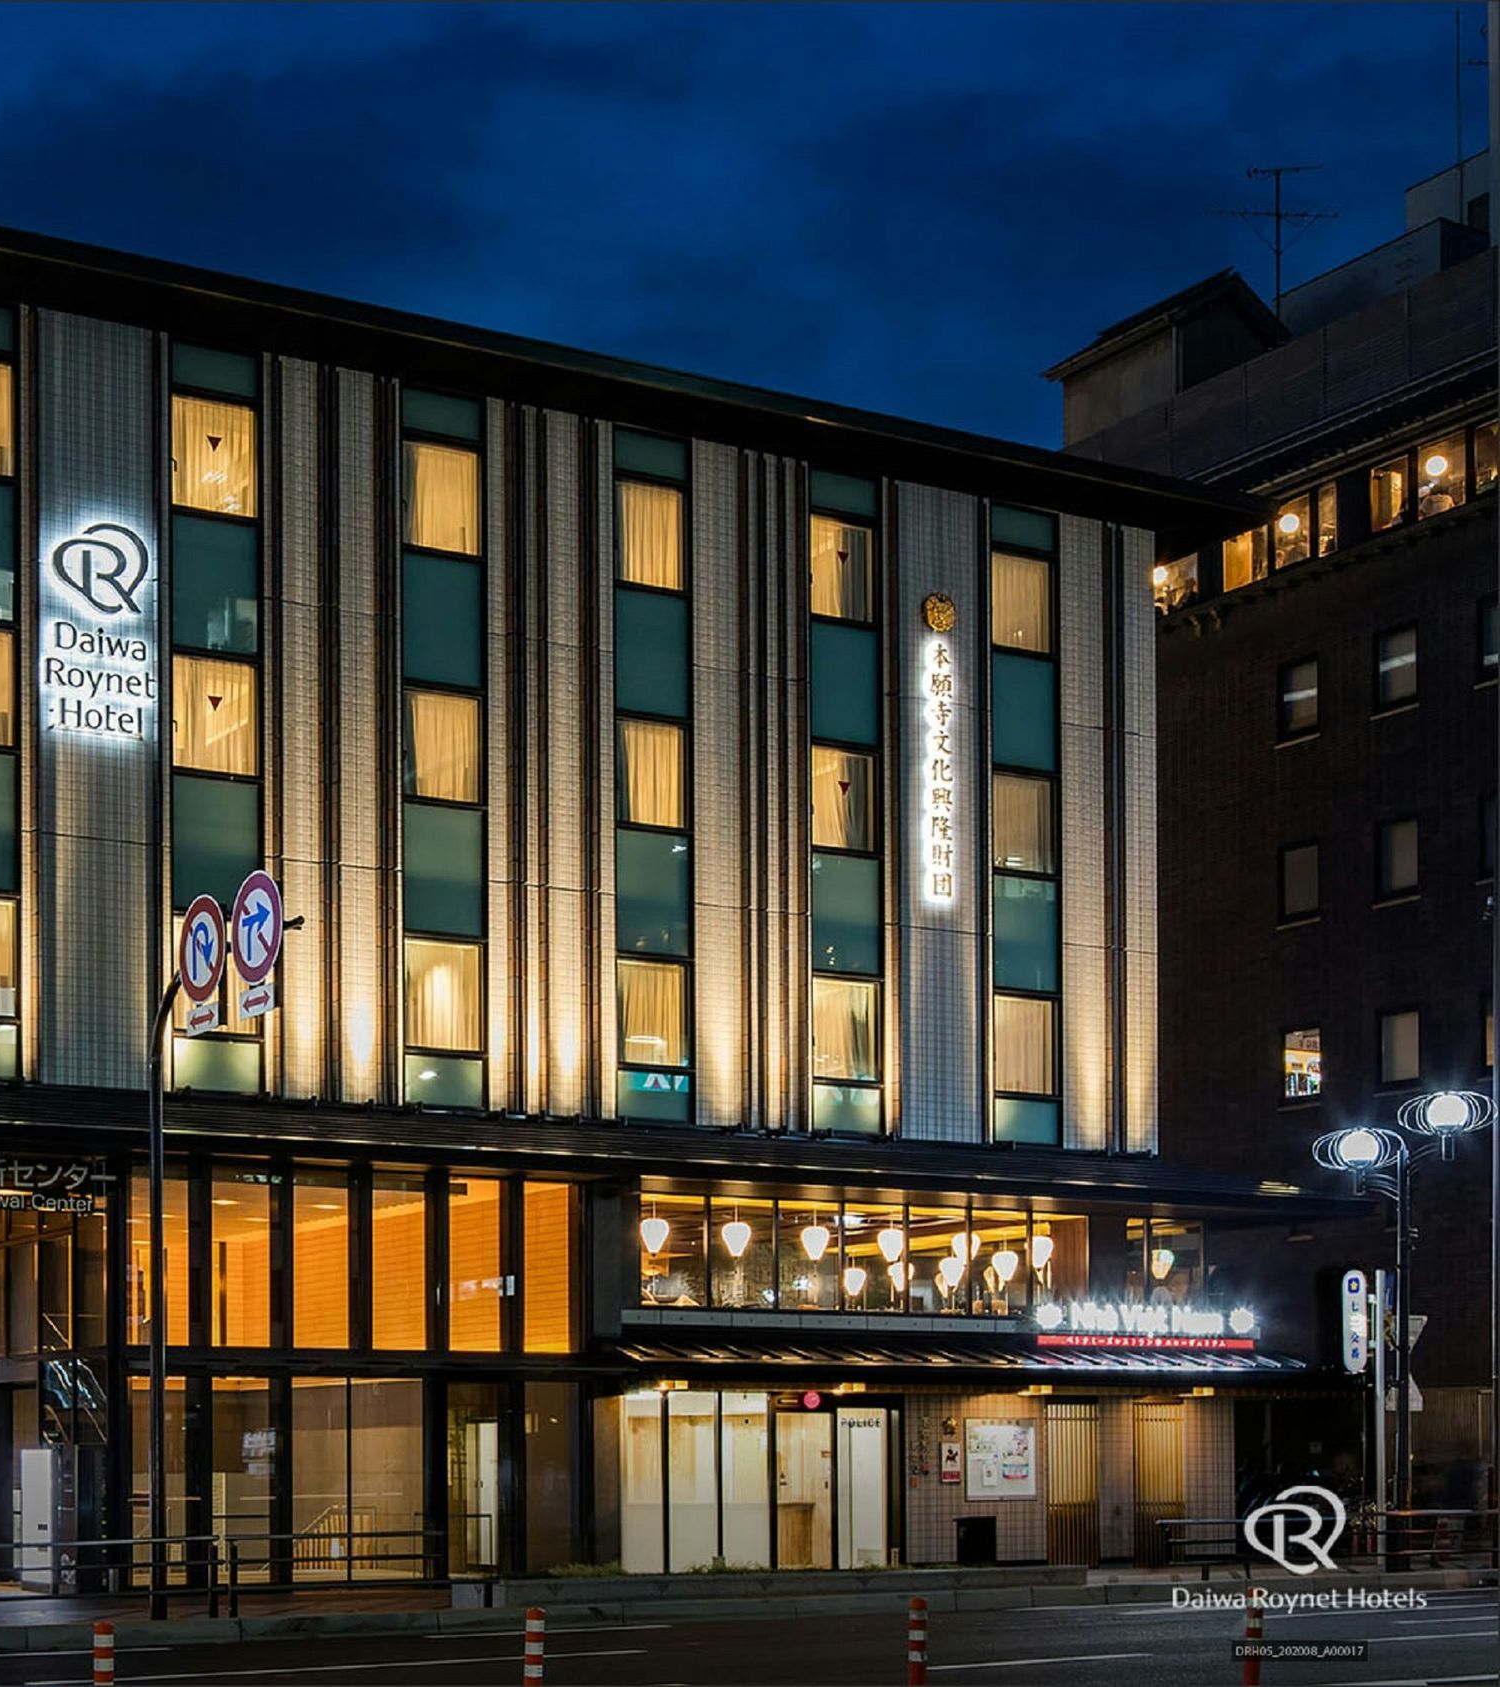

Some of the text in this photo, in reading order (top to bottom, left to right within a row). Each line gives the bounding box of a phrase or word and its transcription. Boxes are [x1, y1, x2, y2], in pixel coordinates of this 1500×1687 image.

[53, 621, 147, 662] Daiwa
[45, 657, 156, 698] Roynet
[60, 698, 143, 735] Hotel
[32, 1193, 94, 1212] Center
[840, 1417, 881, 1428] POLICE
